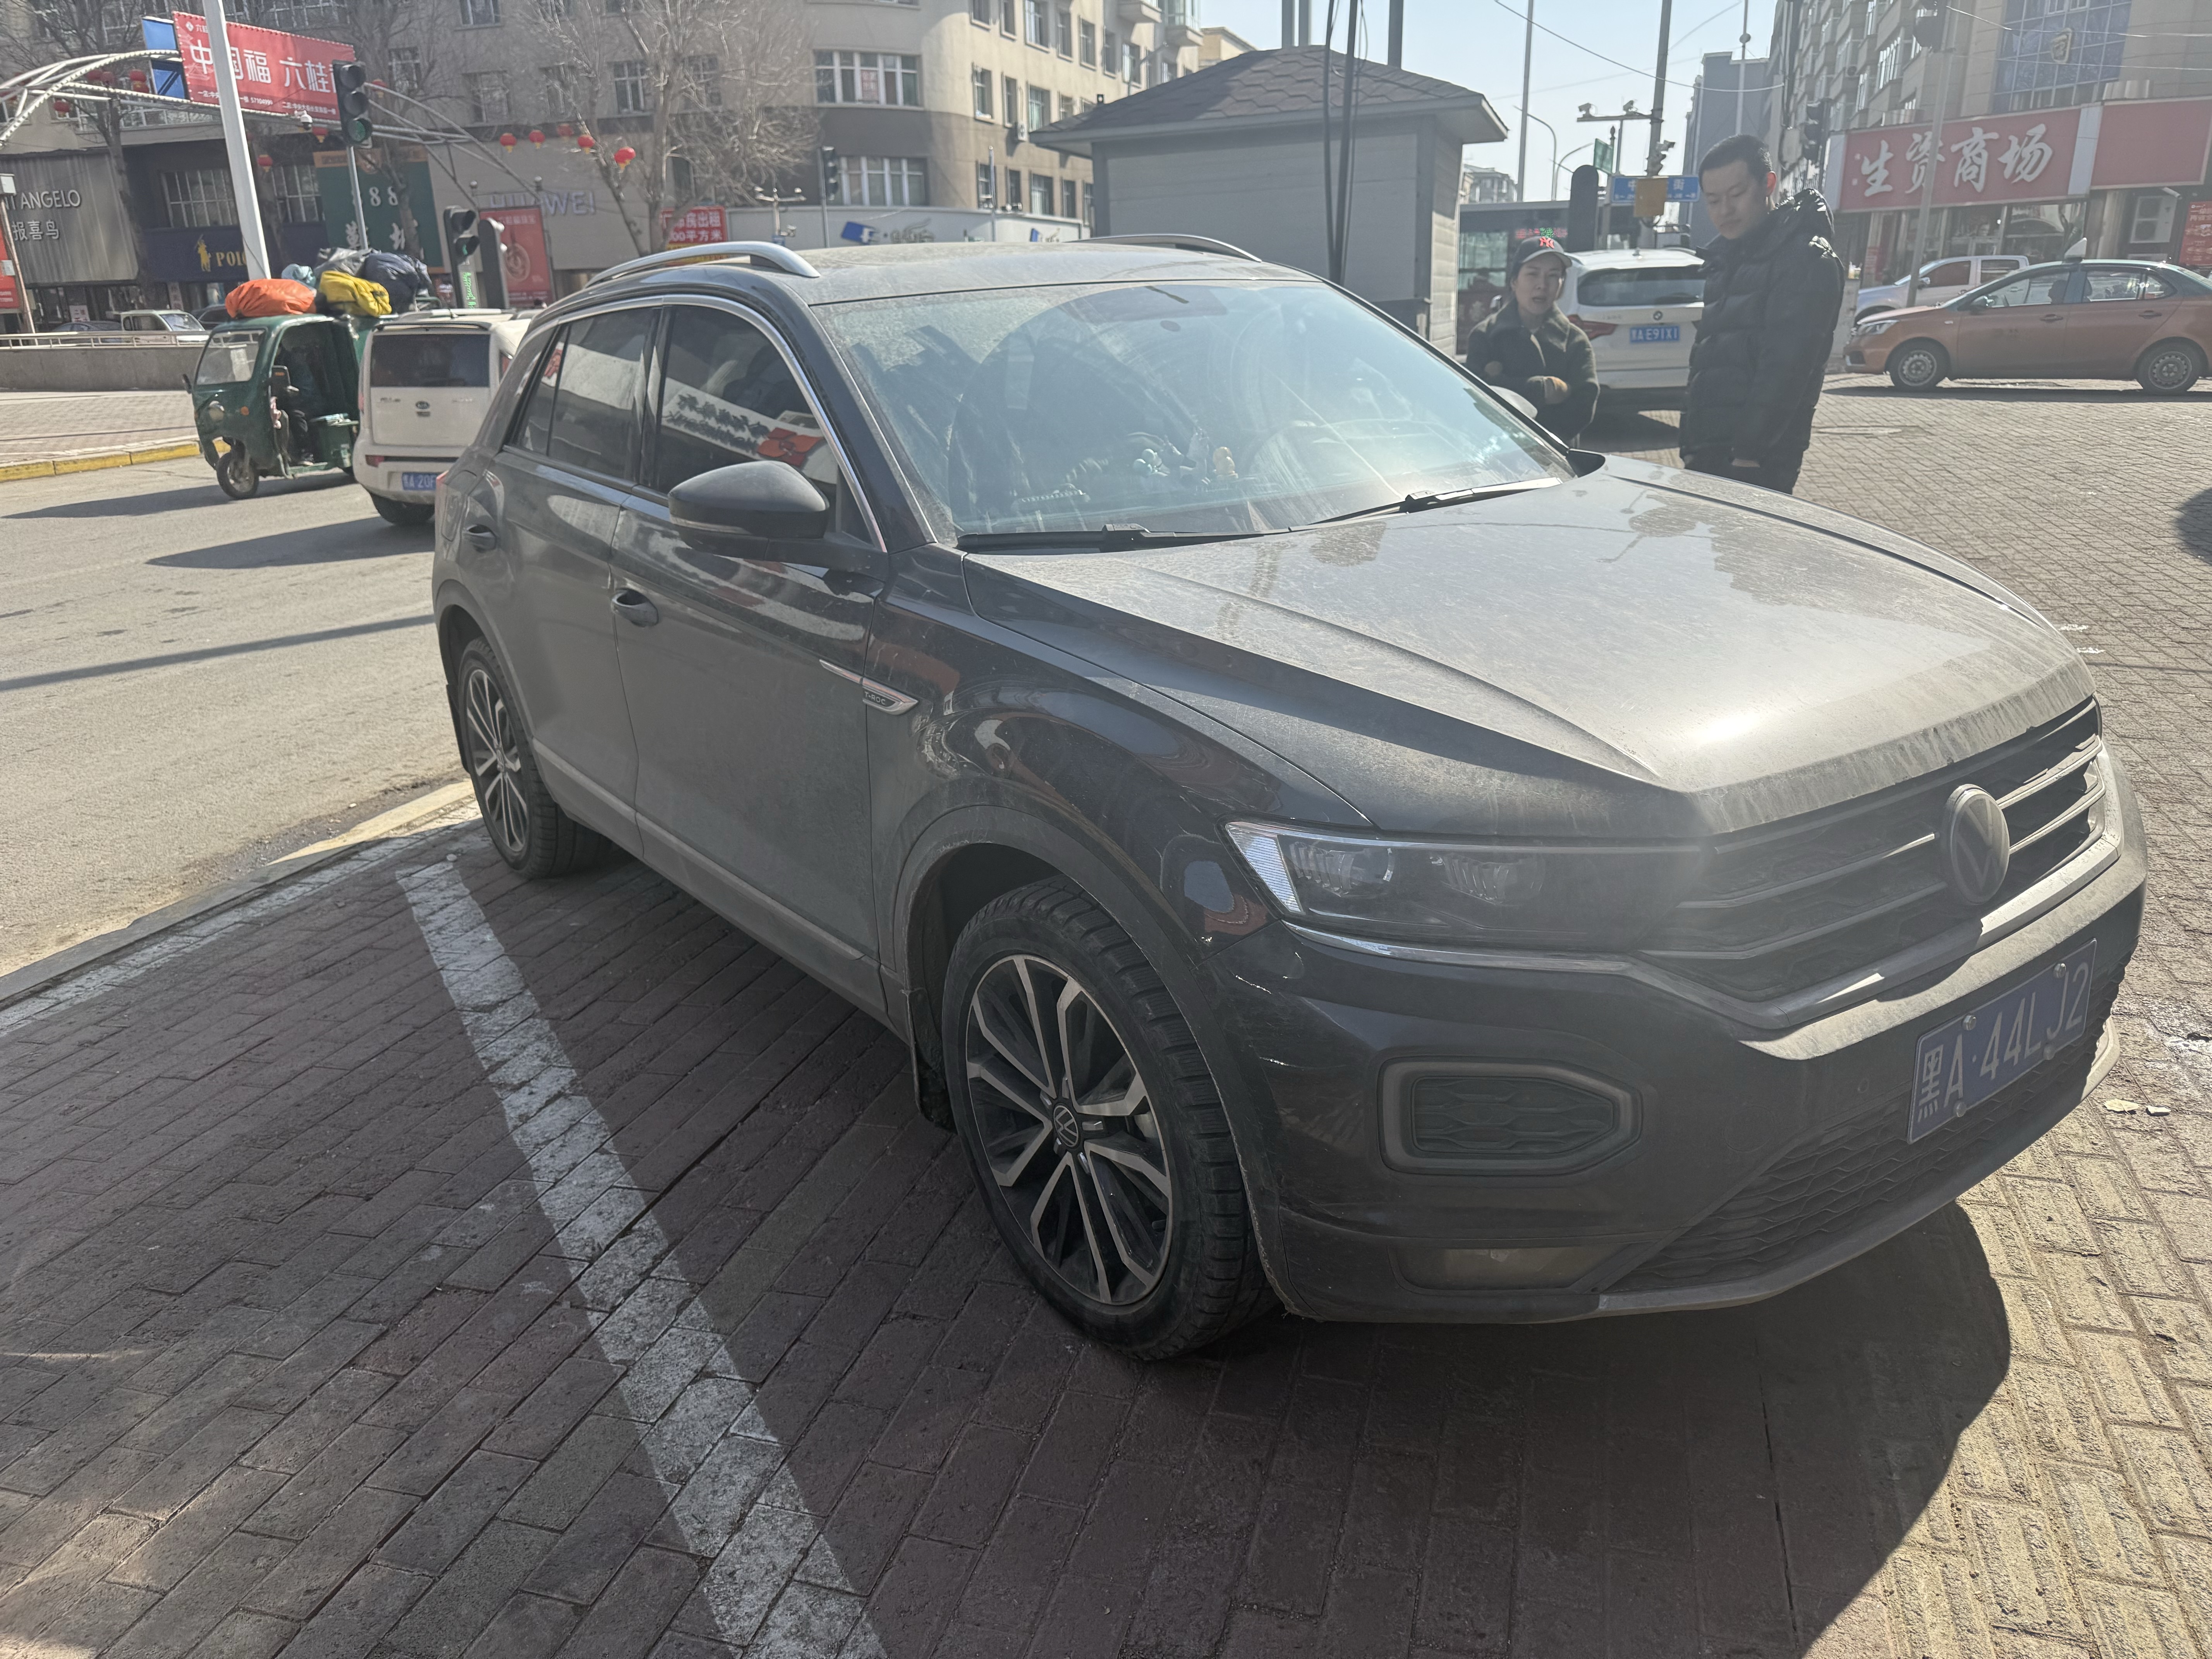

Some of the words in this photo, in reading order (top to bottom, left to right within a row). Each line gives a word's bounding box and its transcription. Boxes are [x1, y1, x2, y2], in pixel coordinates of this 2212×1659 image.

[279, 57, 336, 94] 六桂
[1860, 123, 2053, 197] 生资商场
[21, 189, 81, 210] ANGELO
[12, 220, 60, 241] 报喜鸟
[864, 691, 886, 705] T-ROC
